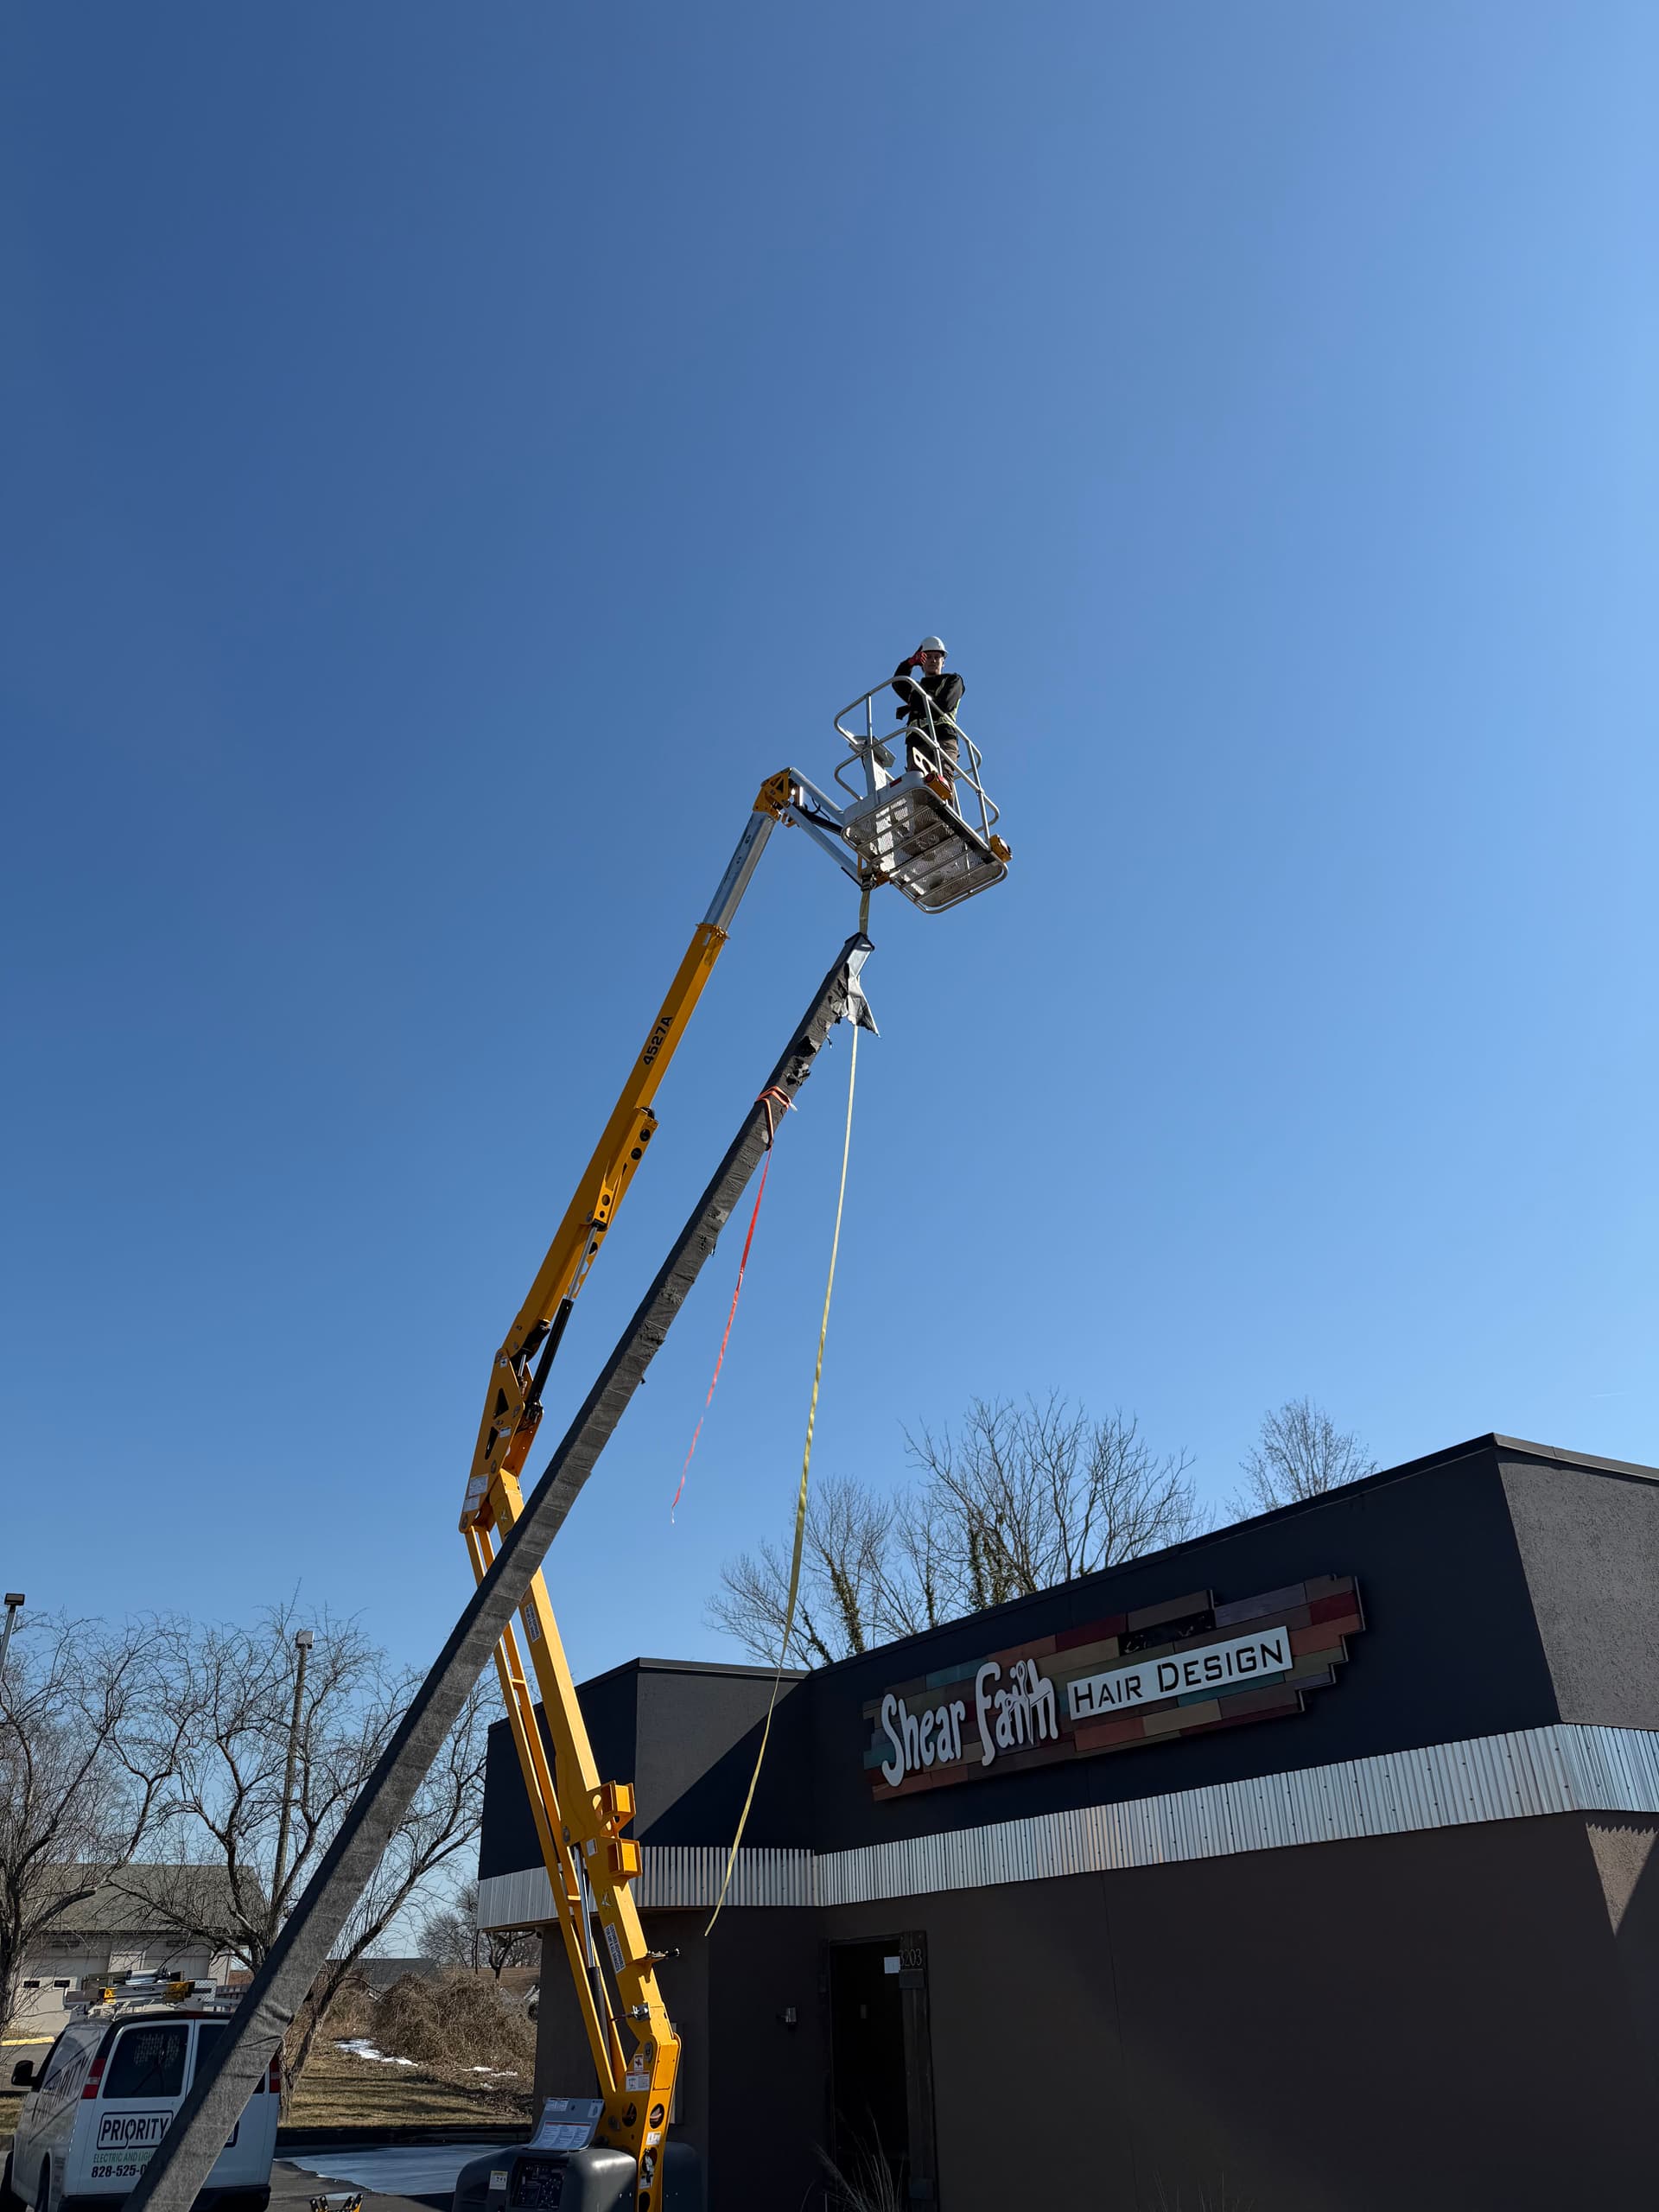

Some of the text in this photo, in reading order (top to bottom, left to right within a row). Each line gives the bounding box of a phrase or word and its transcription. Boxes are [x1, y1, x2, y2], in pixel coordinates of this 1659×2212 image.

[643, 1016, 673, 1065] 4527A
[881, 1639, 1284, 1787] Shear Faith HAIR DESIGN
[101, 2118, 168, 2141] PRIORITY
[93, 2150, 153, 2164] ELECTRIC AND LIGH
[92, 2164, 147, 2177] 828-525-0
